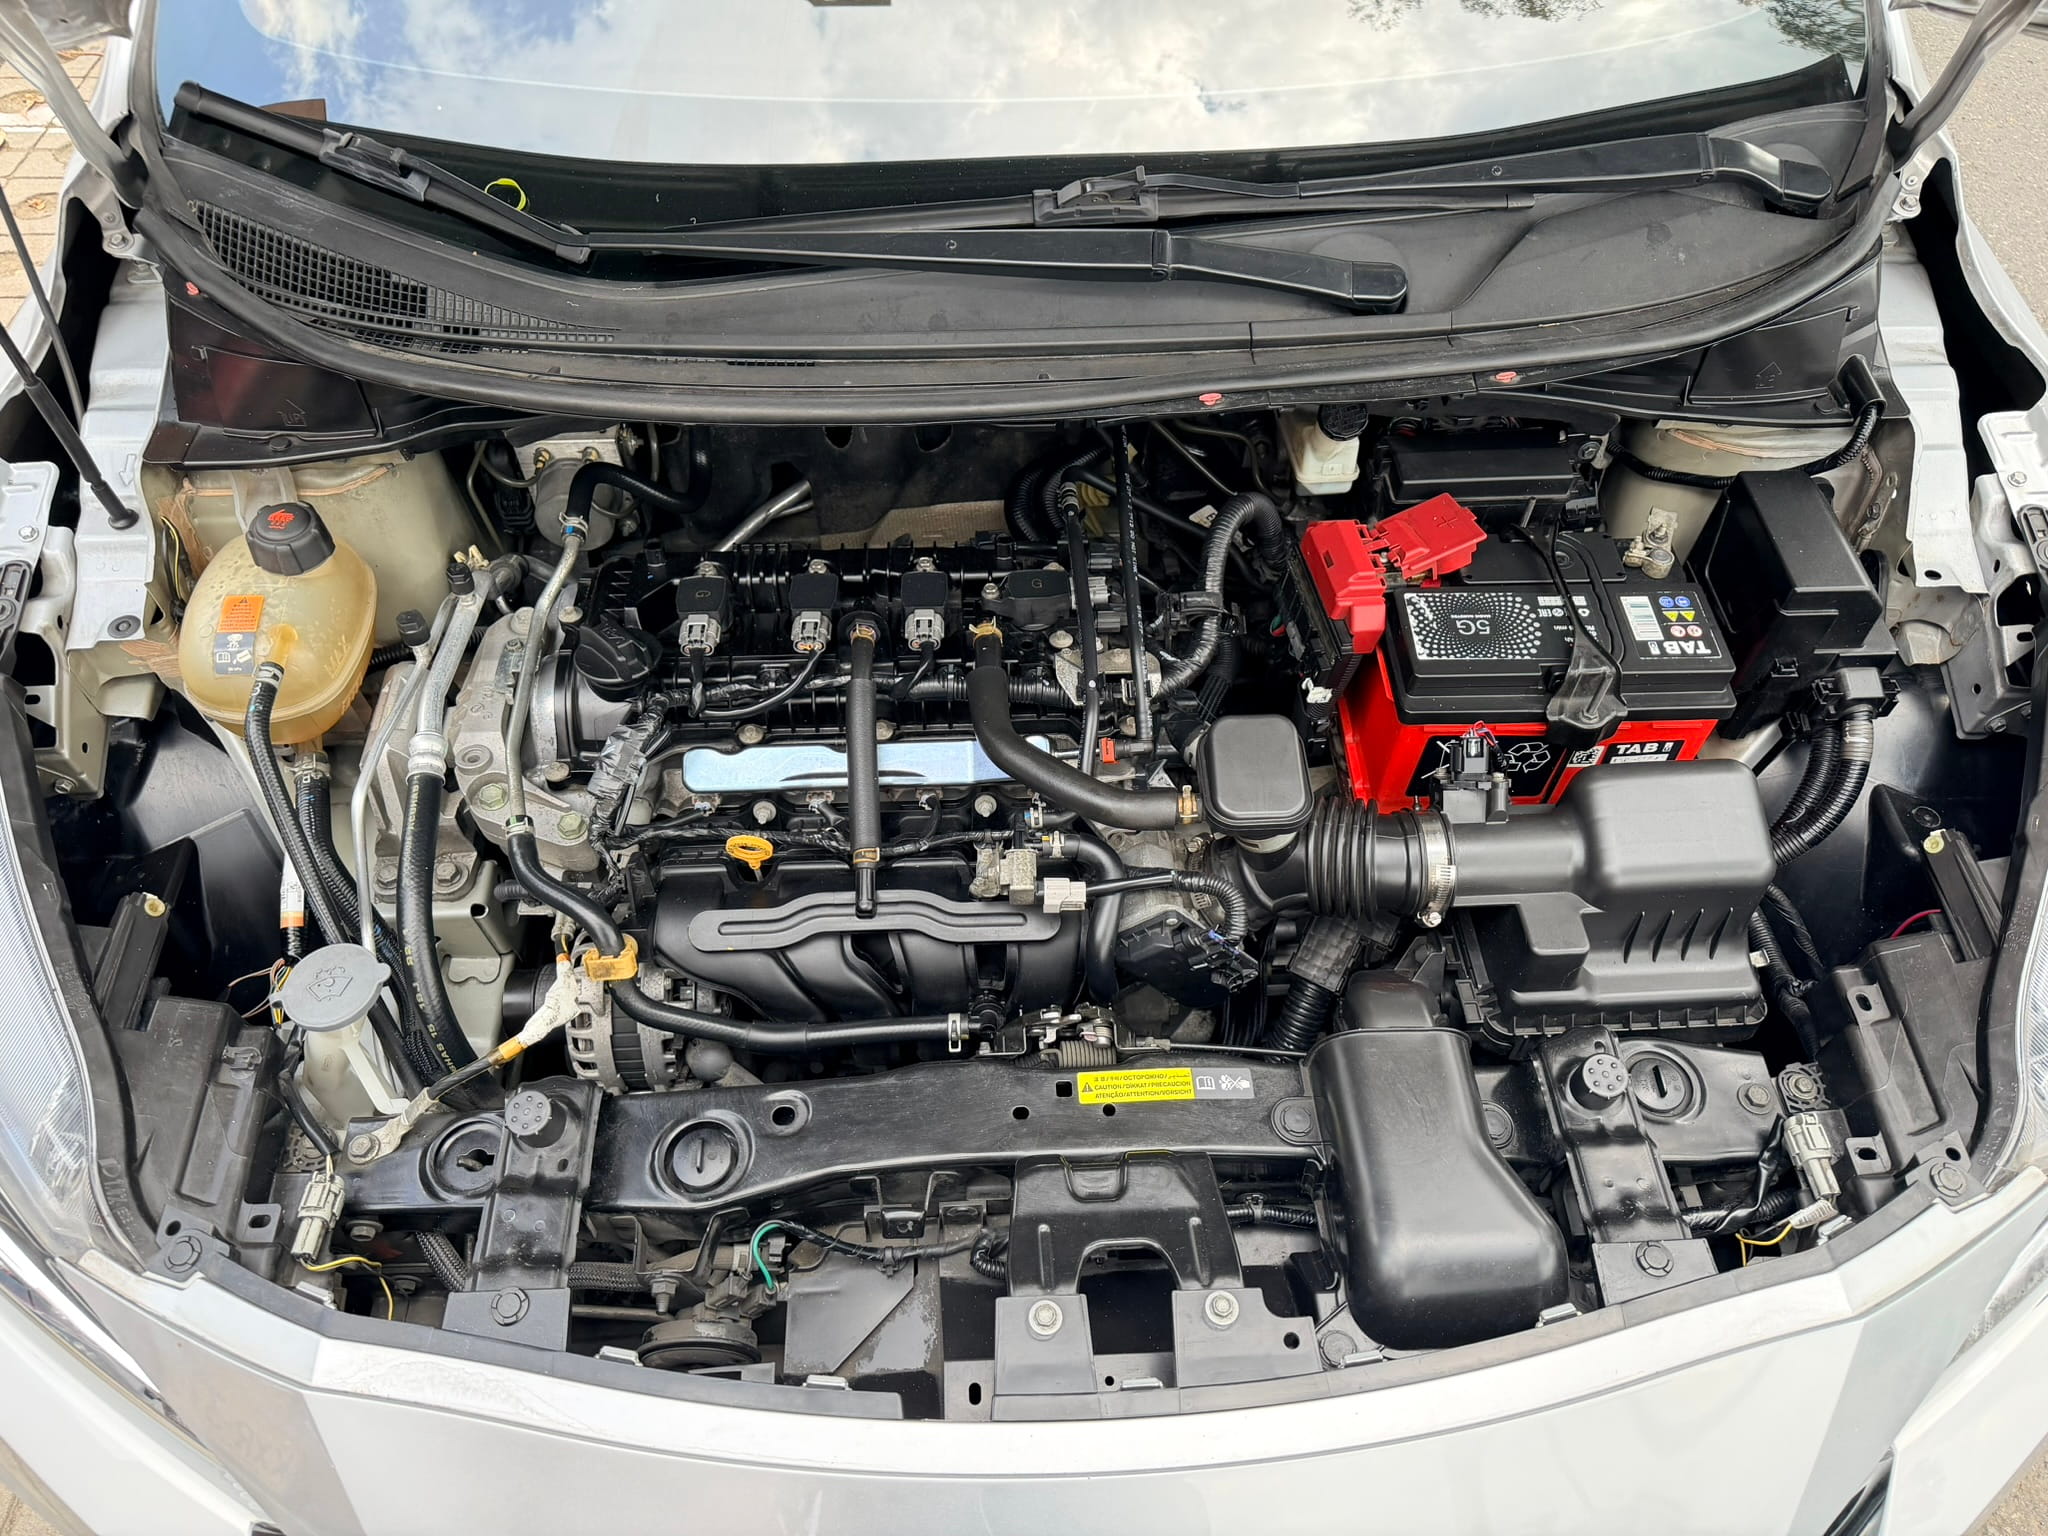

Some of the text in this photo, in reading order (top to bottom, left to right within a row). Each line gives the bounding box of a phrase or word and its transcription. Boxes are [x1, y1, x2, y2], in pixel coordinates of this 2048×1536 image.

[1455, 619, 1490, 635] 5G
[1663, 640, 1712, 654] TAB
[1616, 742, 1659, 754] TAB
